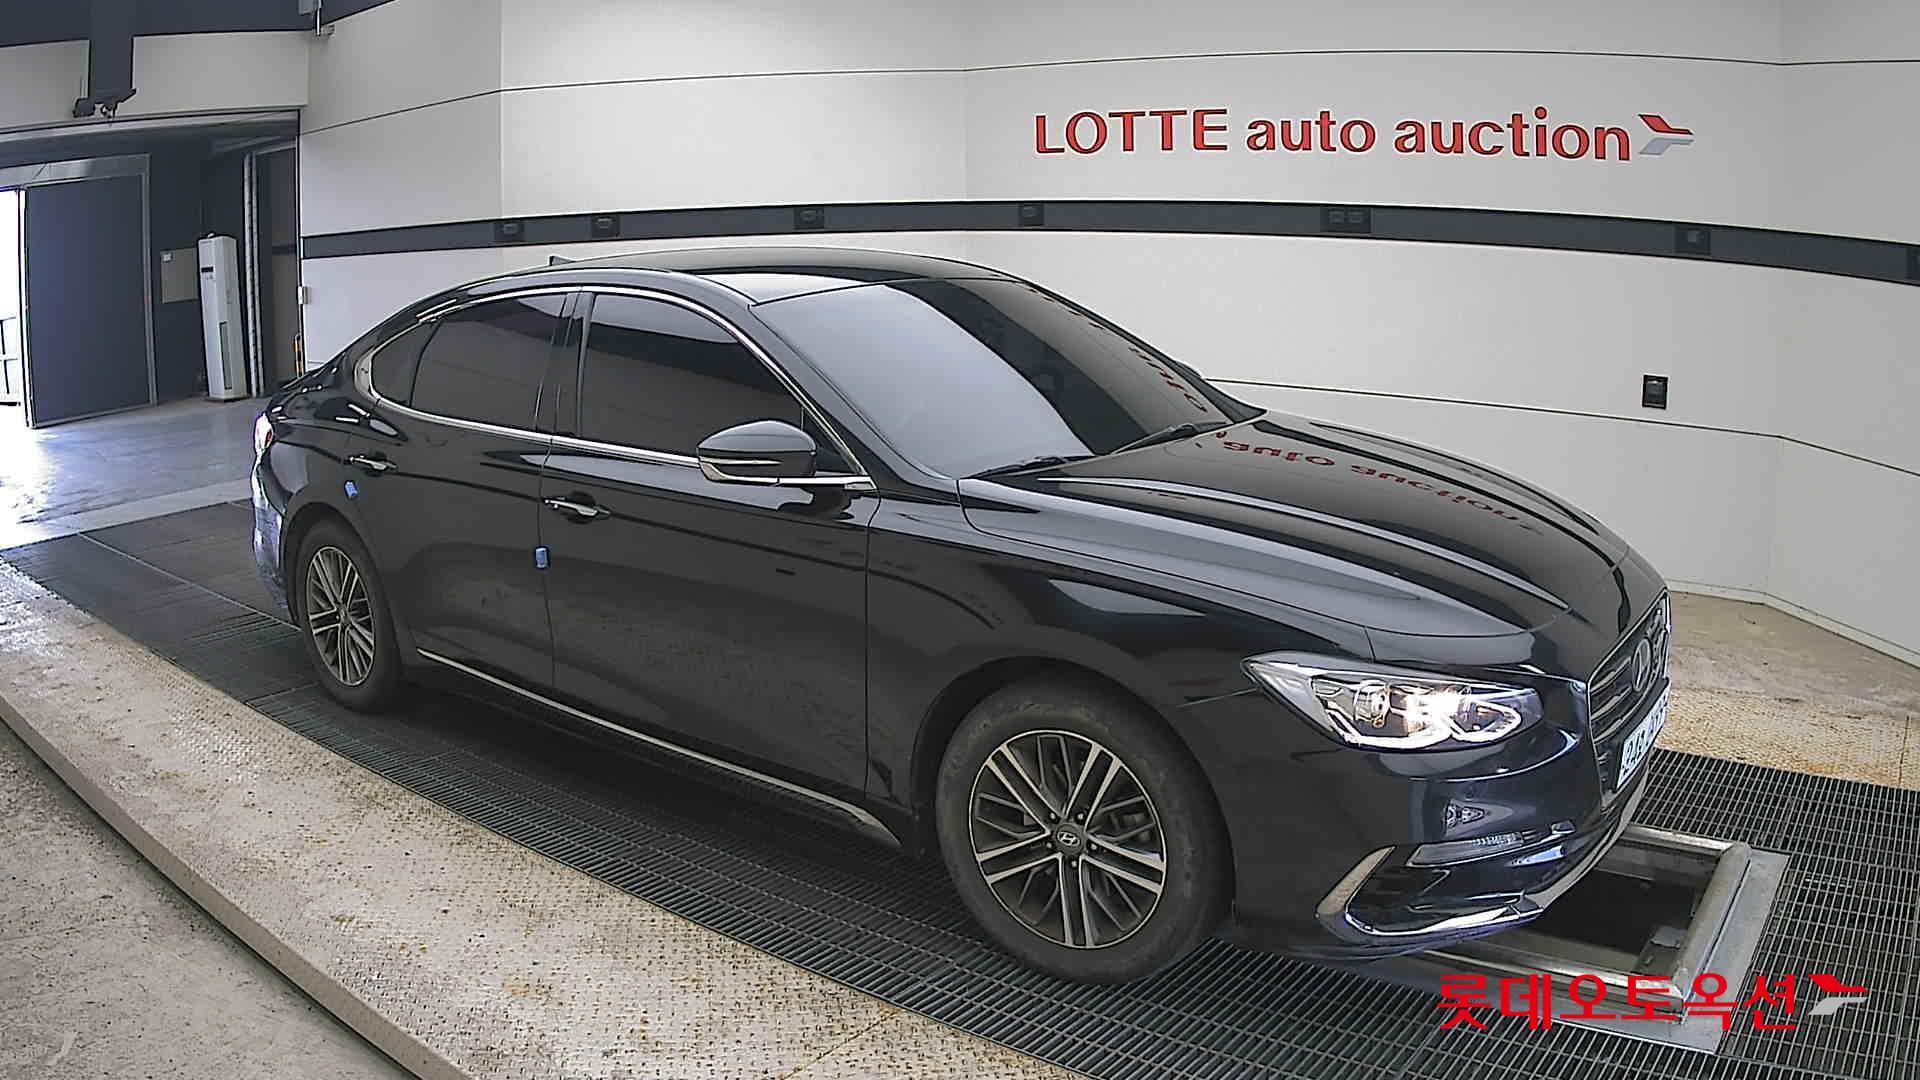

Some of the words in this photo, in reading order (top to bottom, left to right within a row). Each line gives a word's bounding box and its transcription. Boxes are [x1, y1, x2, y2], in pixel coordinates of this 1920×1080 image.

[1035, 109, 1229, 154] LOTTE
[1246, 110, 1377, 152] auto
[1395, 106, 1632, 161] auction
